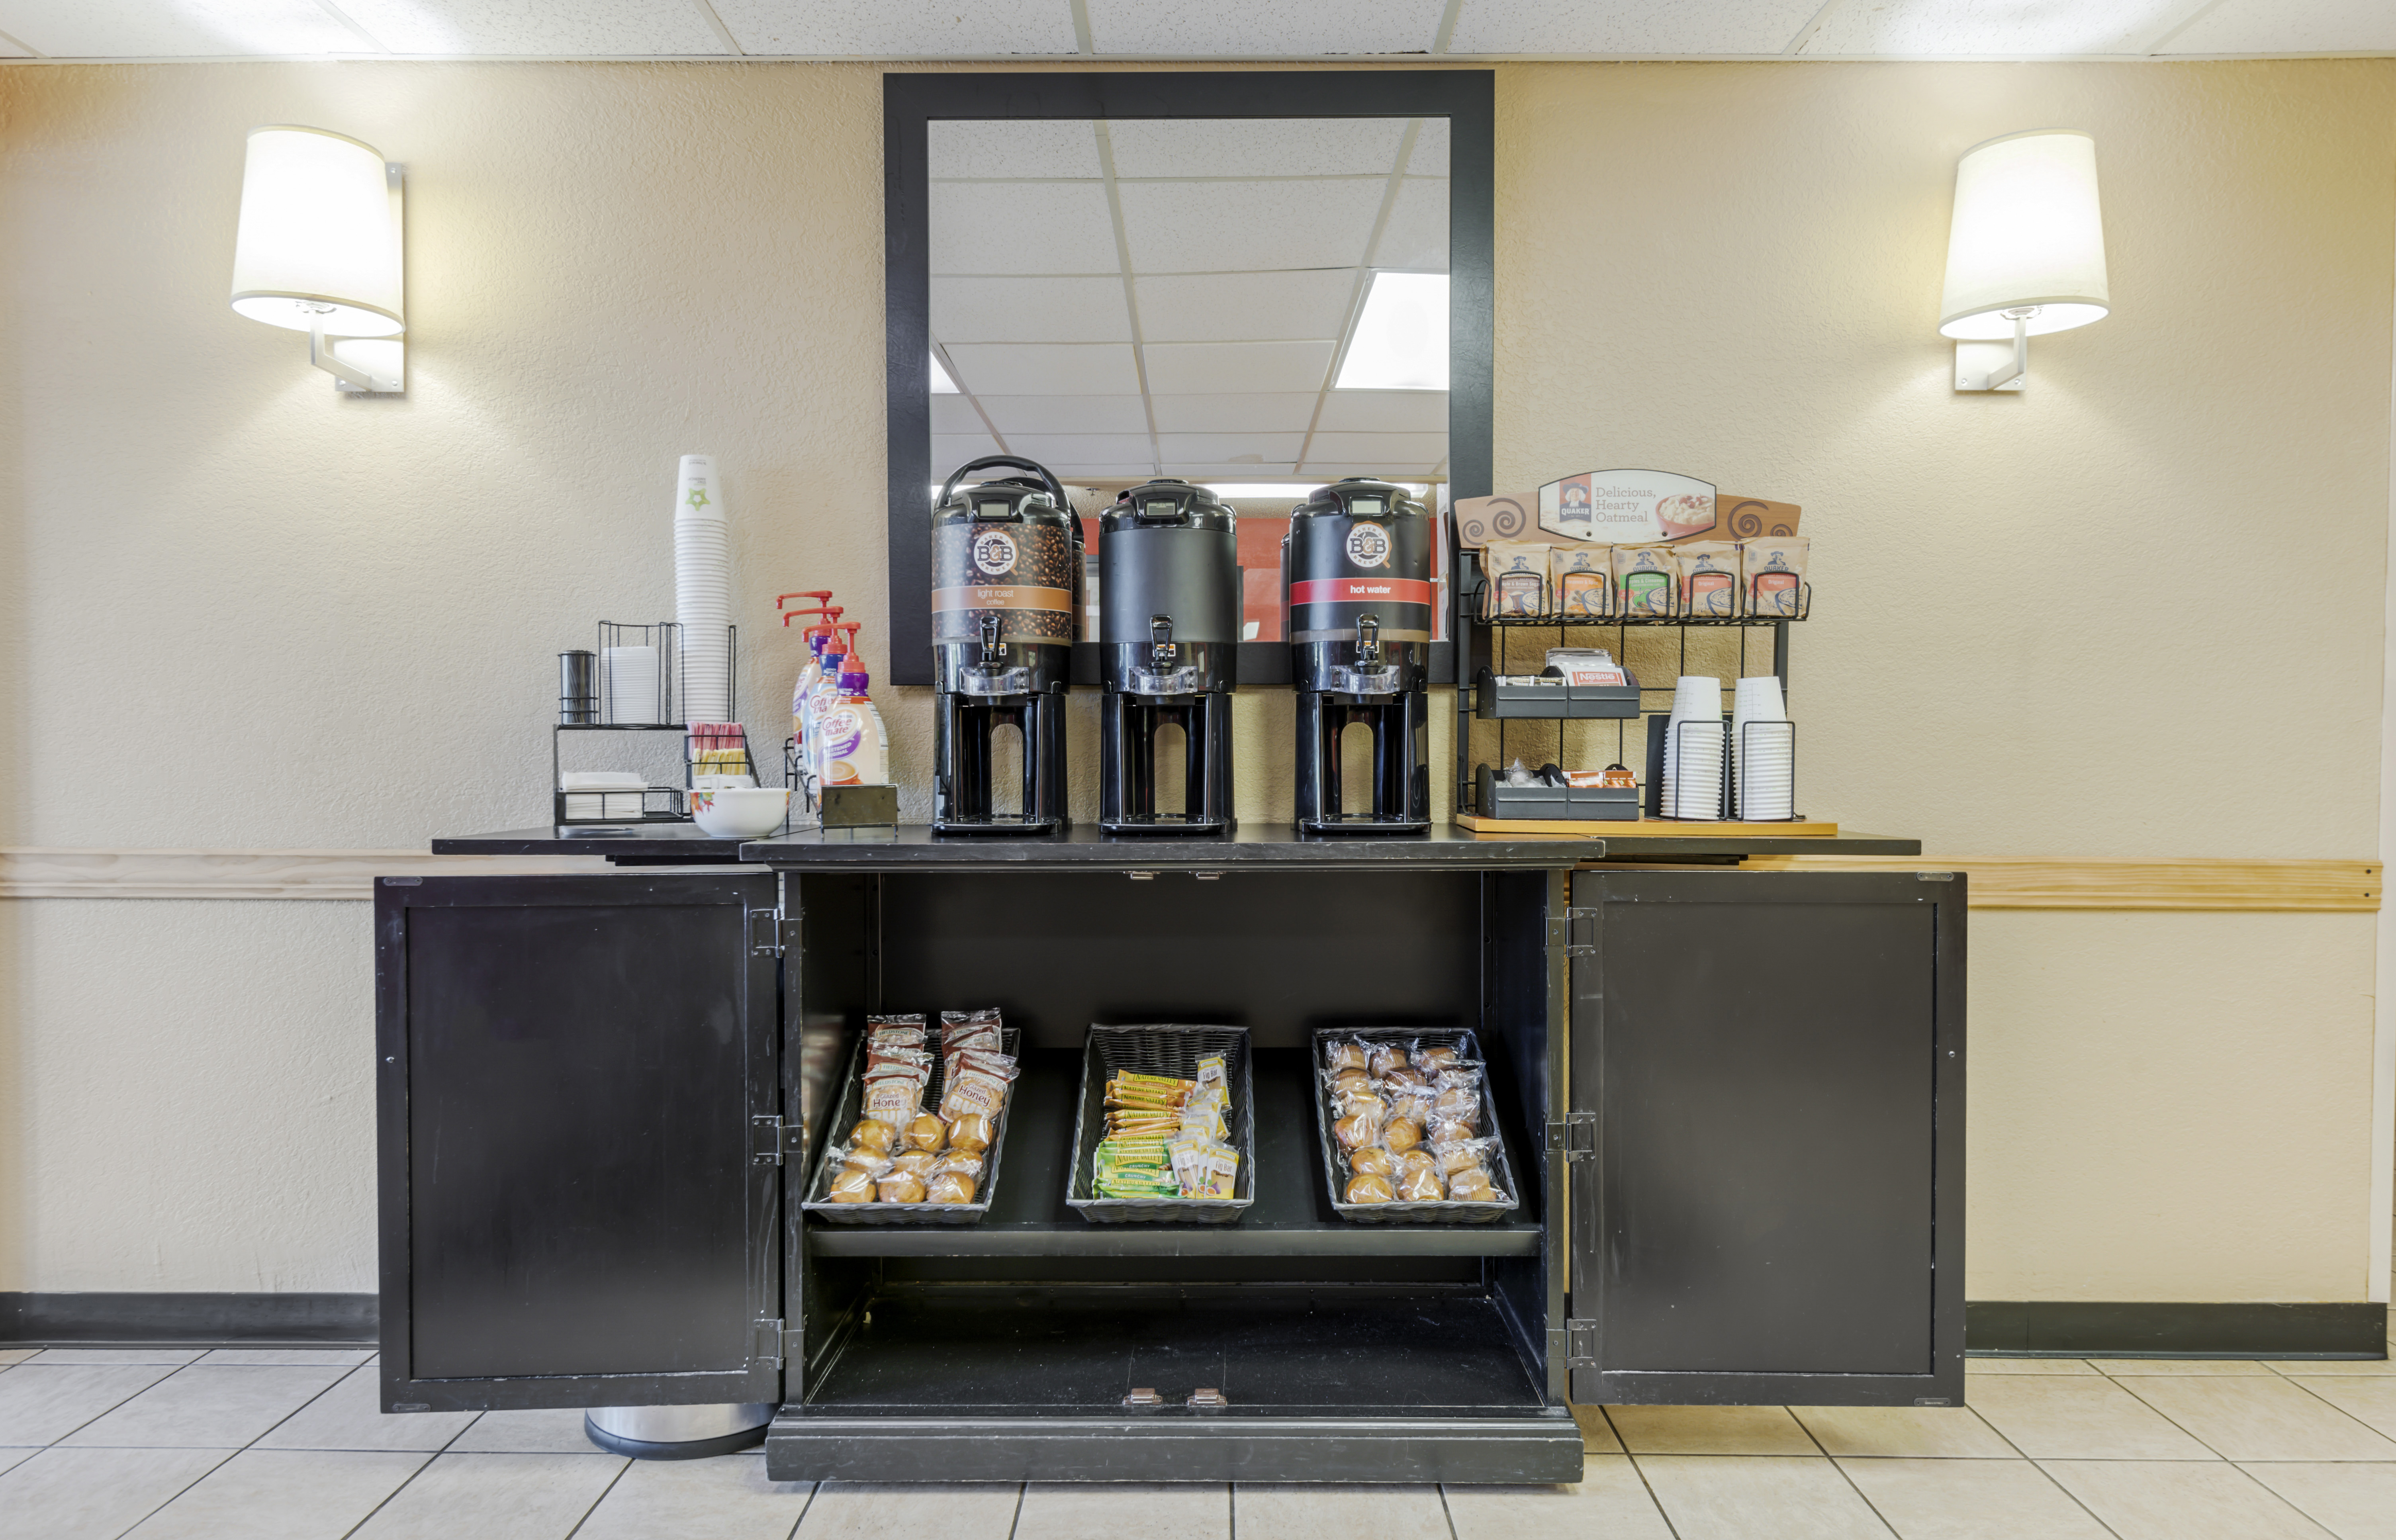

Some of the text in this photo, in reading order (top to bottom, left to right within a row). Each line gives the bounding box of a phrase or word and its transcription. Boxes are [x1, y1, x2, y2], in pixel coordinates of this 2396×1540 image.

[1595, 486, 1656, 499] Delicious,
[1595, 500, 1639, 512] Hearty
[1595, 511, 1648, 522] Oatmeal
[1353, 526, 1376, 537] BAKER
[980, 534, 1003, 545] BAKER
[1350, 538, 1386, 554] B&B
[977, 545, 1013, 562] B&B
[1353, 555, 1383, 565] BREWER
[981, 562, 1010, 572] BREWER
[978, 589, 993, 599] light
[1350, 585, 1391, 594] hot water
[822, 716, 852, 730] Coffee
[825, 726, 849, 736] mate
[1158, 1076, 1177, 1085] VALLEY
[969, 1083, 986, 1094] Glazed
[959, 1085, 991, 1107] Honey
[947, 1094, 992, 1115] BUN
[1117, 1155, 1140, 1164] NATURE
[1177, 1155, 1194, 1166] Fig Bar
[1224, 1164, 1232, 1172] Bar
